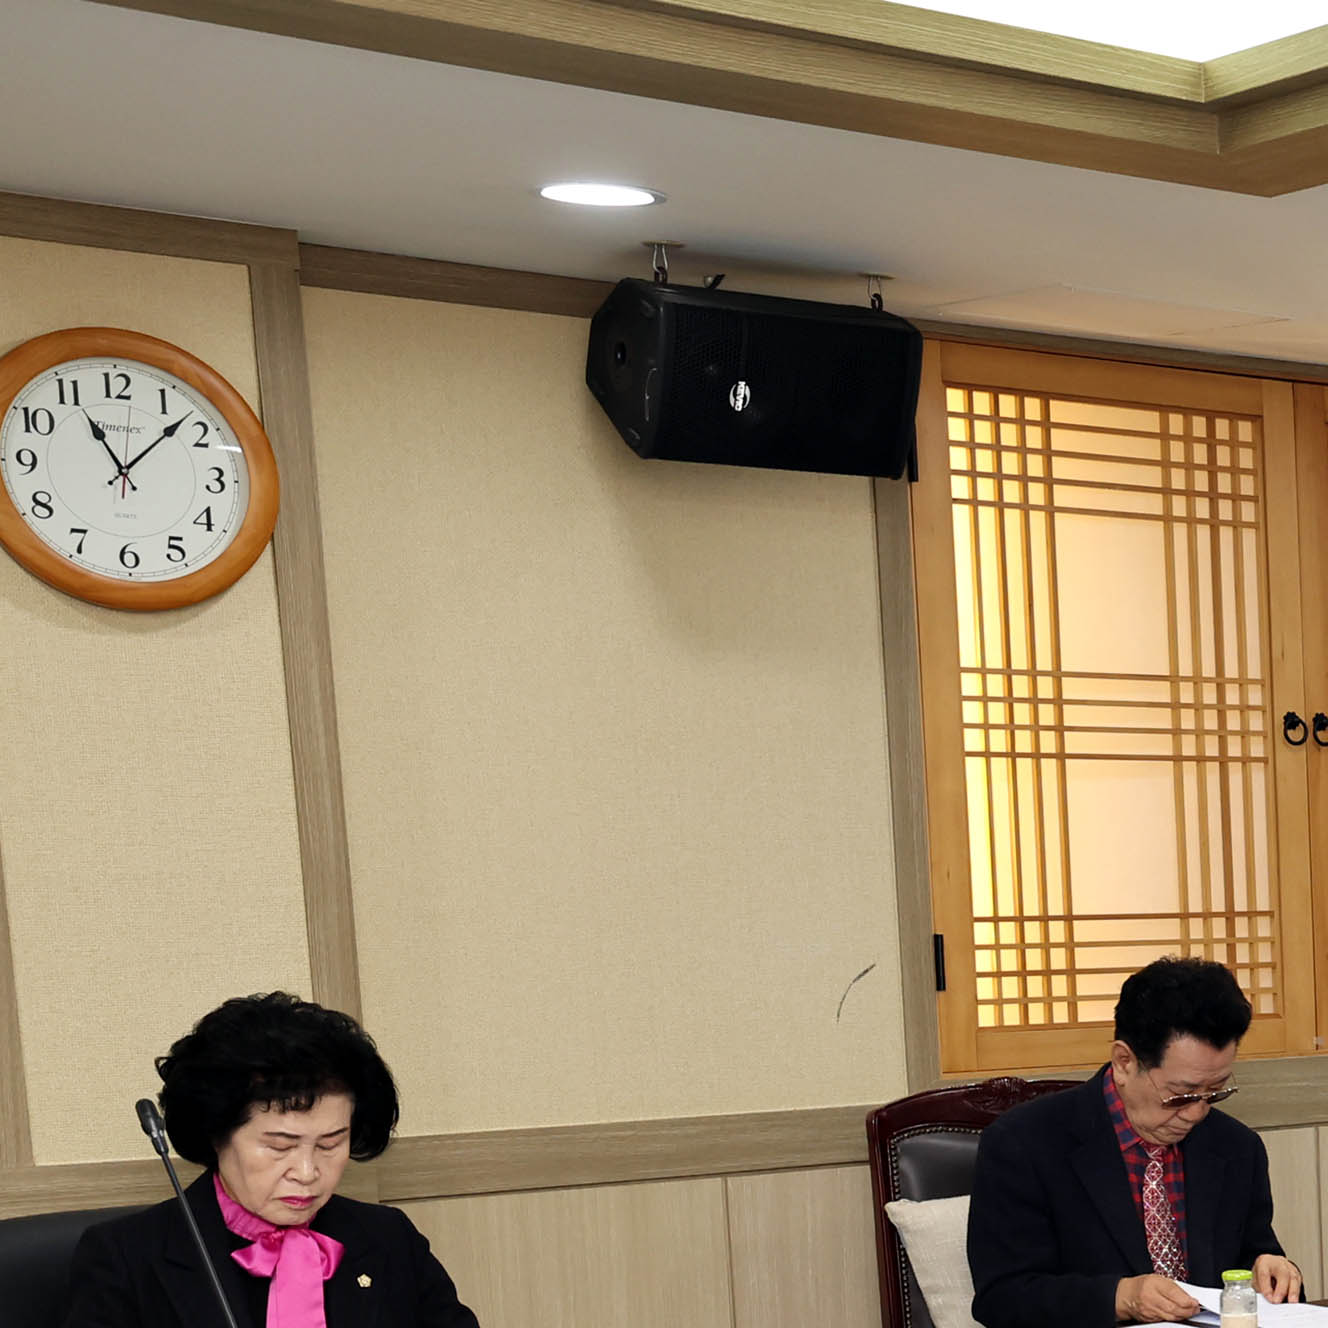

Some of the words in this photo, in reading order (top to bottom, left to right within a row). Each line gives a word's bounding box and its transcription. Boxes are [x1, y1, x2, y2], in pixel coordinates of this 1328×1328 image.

[56, 378, 81, 406] 11
[102, 372, 132, 400] 12
[157, 388, 168, 415] 1
[22, 406, 55, 436] 10
[192, 421, 210, 448] 2
[15, 448, 38, 475] 9
[205, 466, 226, 494] 3
[31, 491, 54, 519] 8
[193, 506, 215, 532] 4
[69, 528, 88, 555] 7
[166, 536, 186, 562] 5
[119, 542, 140, 569] 6
